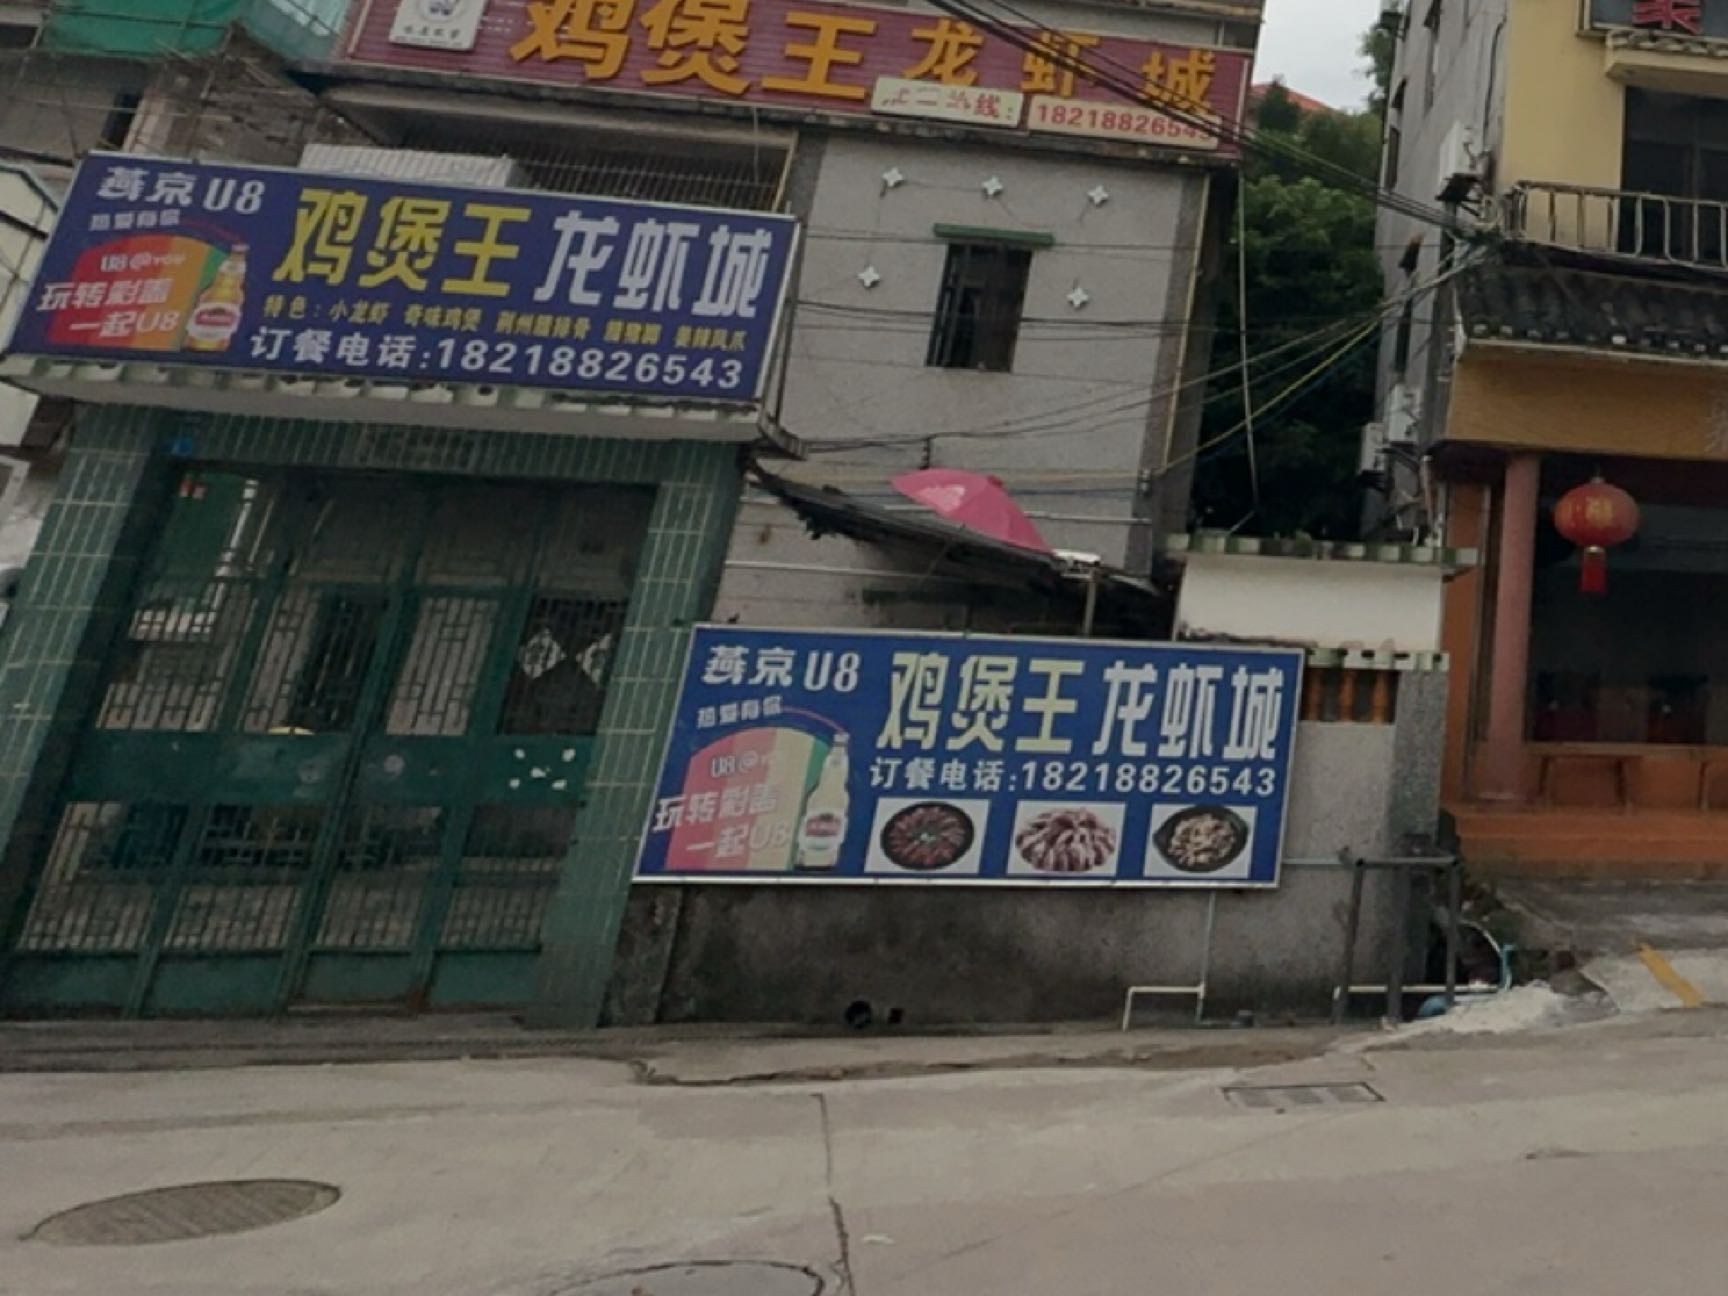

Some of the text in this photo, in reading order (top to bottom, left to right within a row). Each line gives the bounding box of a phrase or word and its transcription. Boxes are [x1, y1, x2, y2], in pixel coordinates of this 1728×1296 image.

[273, 186, 773, 318] 鸡煲王龙虾城
[701, 644, 860, 693] 燕京U8
[876, 650, 1284, 761] 鸡煲王龙虾城
